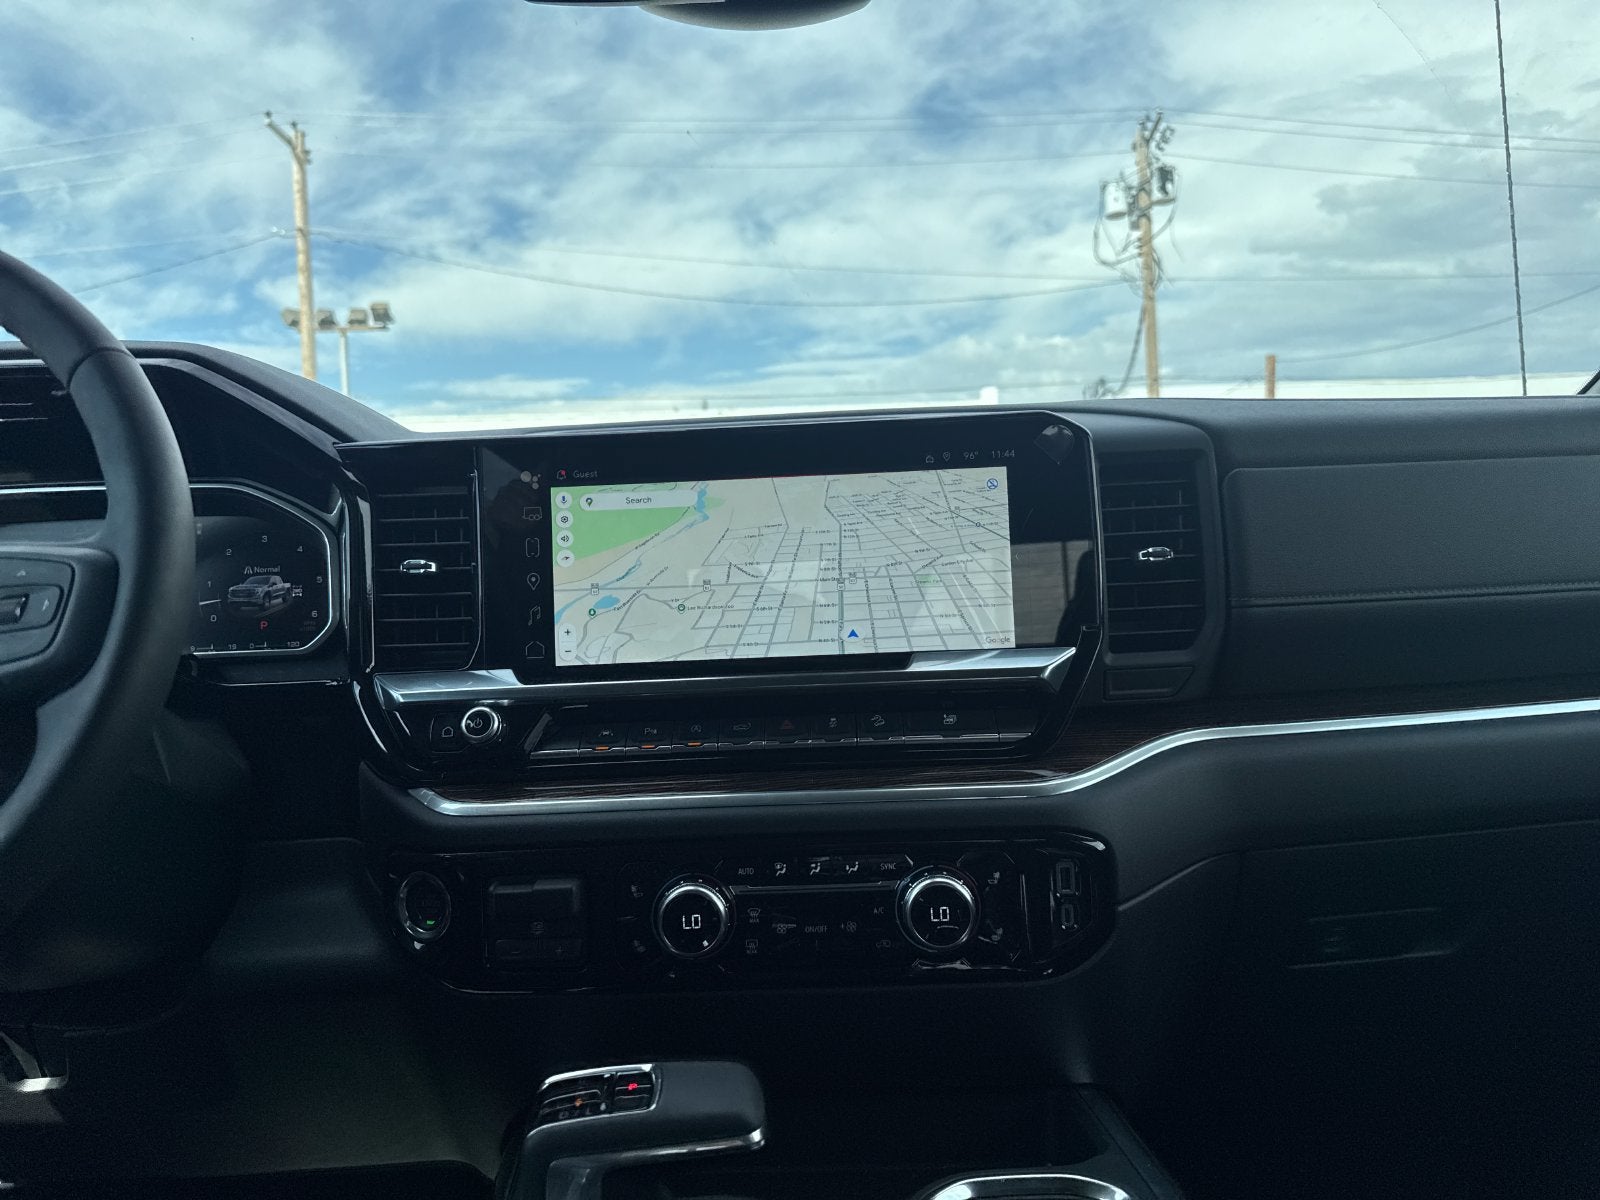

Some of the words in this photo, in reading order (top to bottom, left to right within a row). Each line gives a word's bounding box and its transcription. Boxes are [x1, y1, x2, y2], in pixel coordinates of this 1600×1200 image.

[991, 449, 1015, 459] 11:44
[573, 470, 598, 479] Guest
[625, 496, 652, 505] Search
[261, 535, 268, 543] 3
[226, 548, 232, 556] 2
[254, 565, 281, 573] Normal
[210, 614, 217, 622] 0
[260, 620, 268, 629] P
[985, 636, 1011, 645] Google
[880, 862, 896, 870] SYNC
[738, 867, 755, 875] AUTO
[873, 906, 885, 914] A/C
[930, 906, 950, 922] LO
[682, 914, 701, 930] LO
[804, 925, 828, 933] ON/OFF
